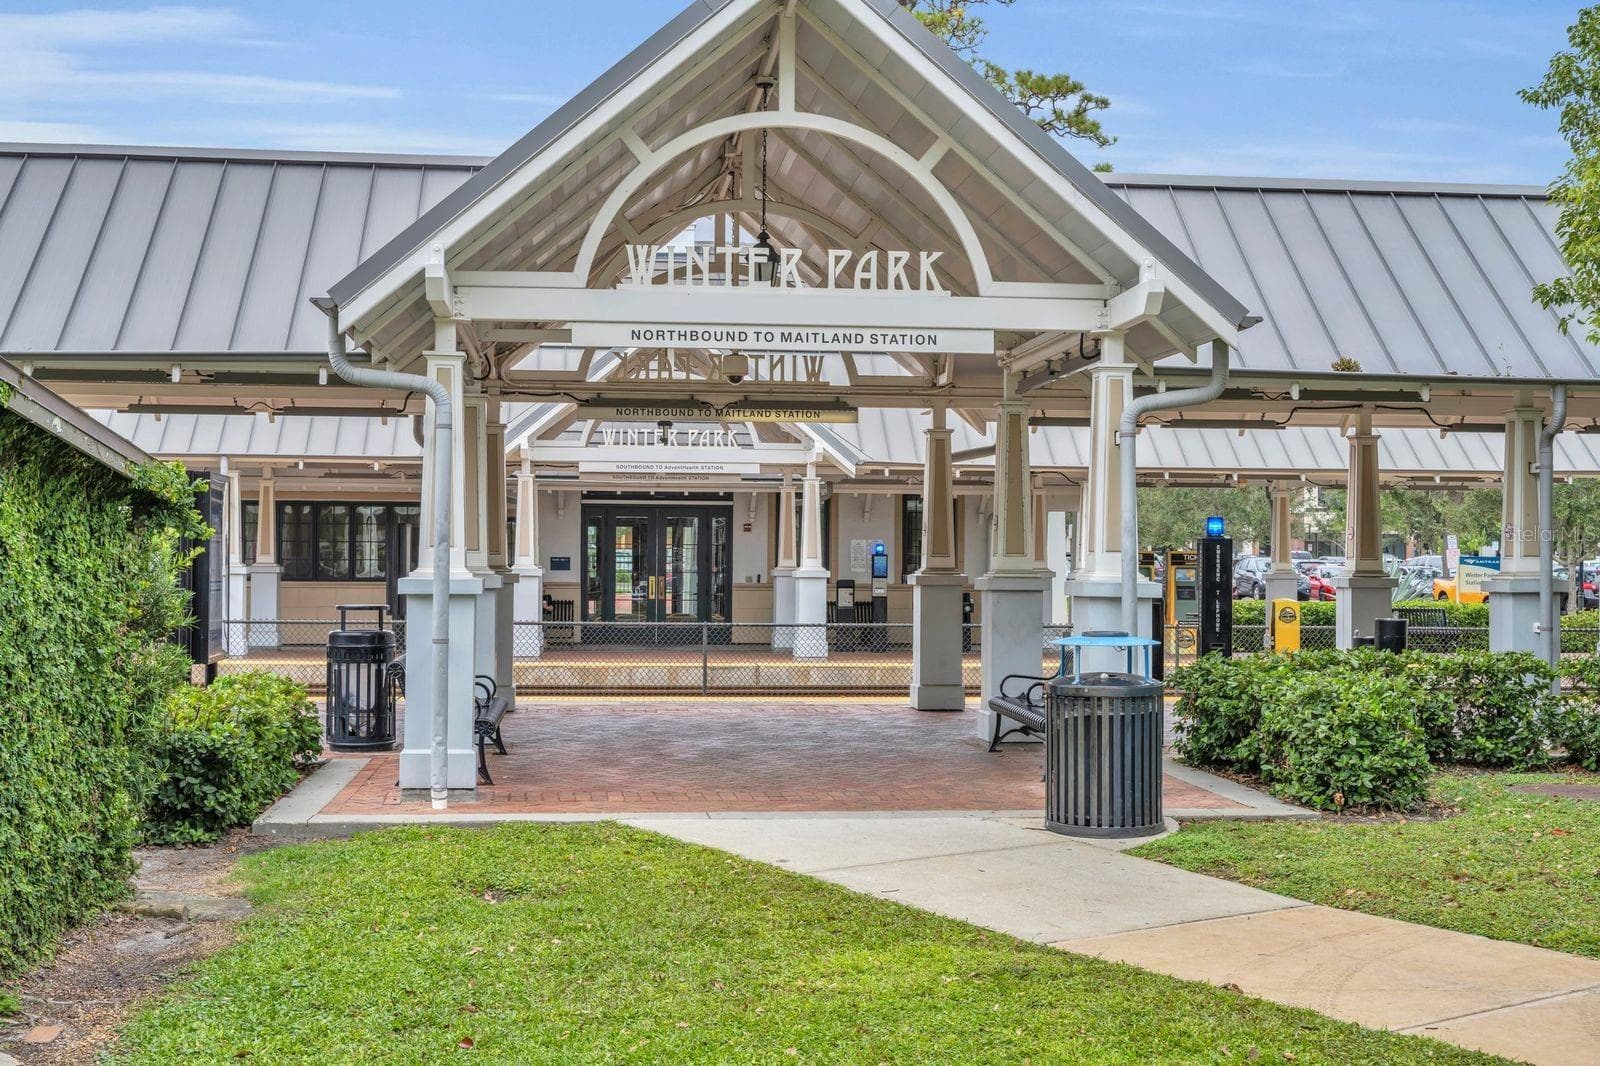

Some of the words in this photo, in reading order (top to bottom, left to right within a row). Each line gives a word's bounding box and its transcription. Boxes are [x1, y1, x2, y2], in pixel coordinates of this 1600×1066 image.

[625, 244, 803, 289] WINTER
[828, 249, 945, 294] PARK
[631, 329, 748, 342] NORTHBOUND
[754, 331, 775, 343] TO
[780, 332, 864, 344] MAITLAND
[869, 333, 938, 346] STATION
[616, 407, 694, 417] NORTHBOUND
[698, 408, 712, 418] TO
[715, 409, 772, 419] MAITLAND
[774, 410, 821, 419] STATION
[603, 428, 679, 447] WINTER
[688, 429, 739, 447] PARK
